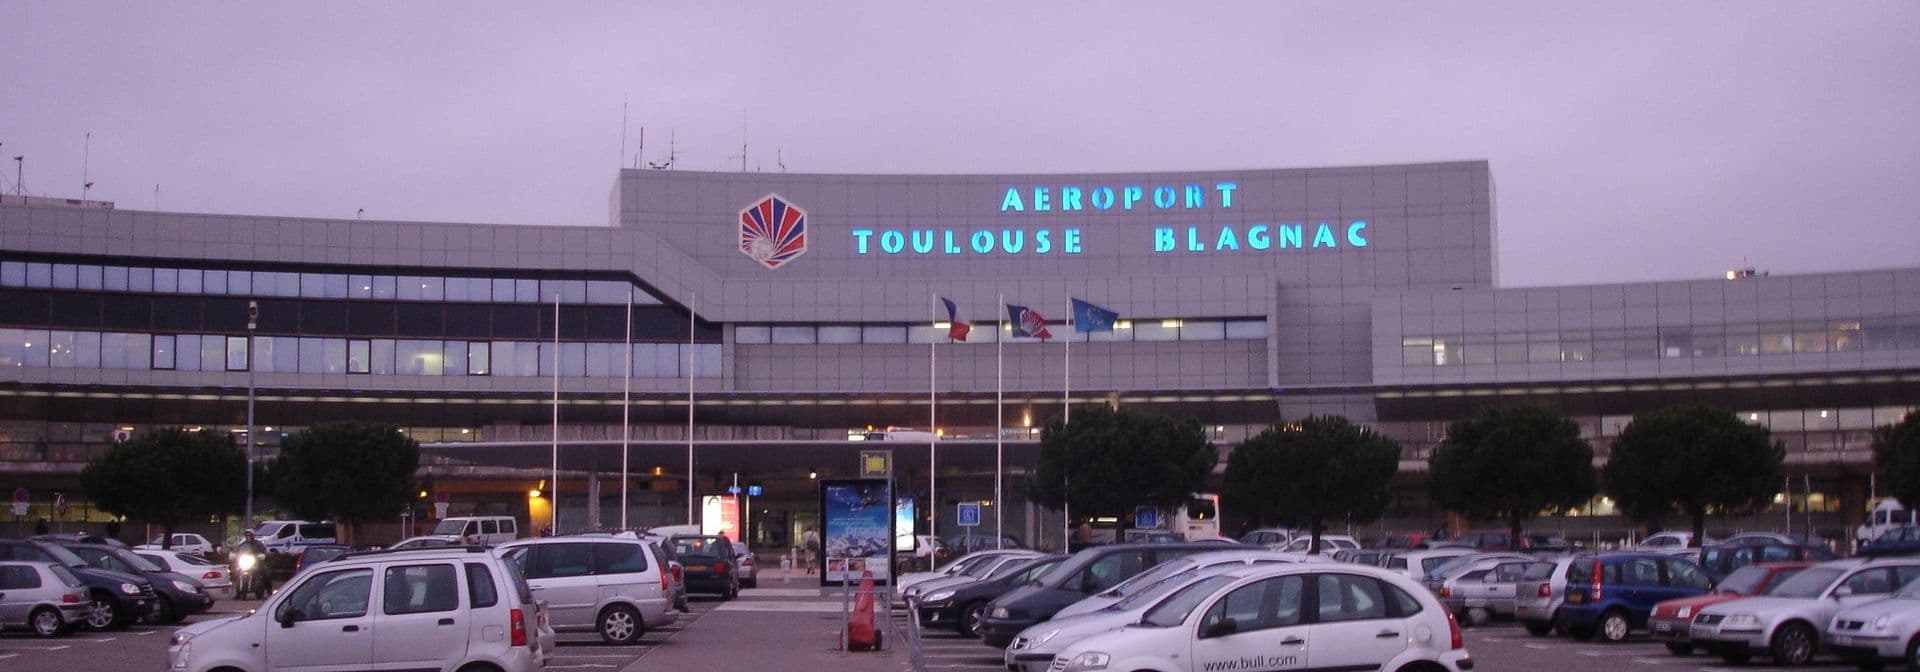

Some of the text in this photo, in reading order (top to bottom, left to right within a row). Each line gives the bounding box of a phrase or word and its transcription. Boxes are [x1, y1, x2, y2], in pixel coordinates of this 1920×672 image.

[1001, 183, 1238, 212] AEROPORT
[852, 220, 1368, 255] TOULOUSE BLAGNAC
[1203, 655, 1297, 671] www.bull.com
